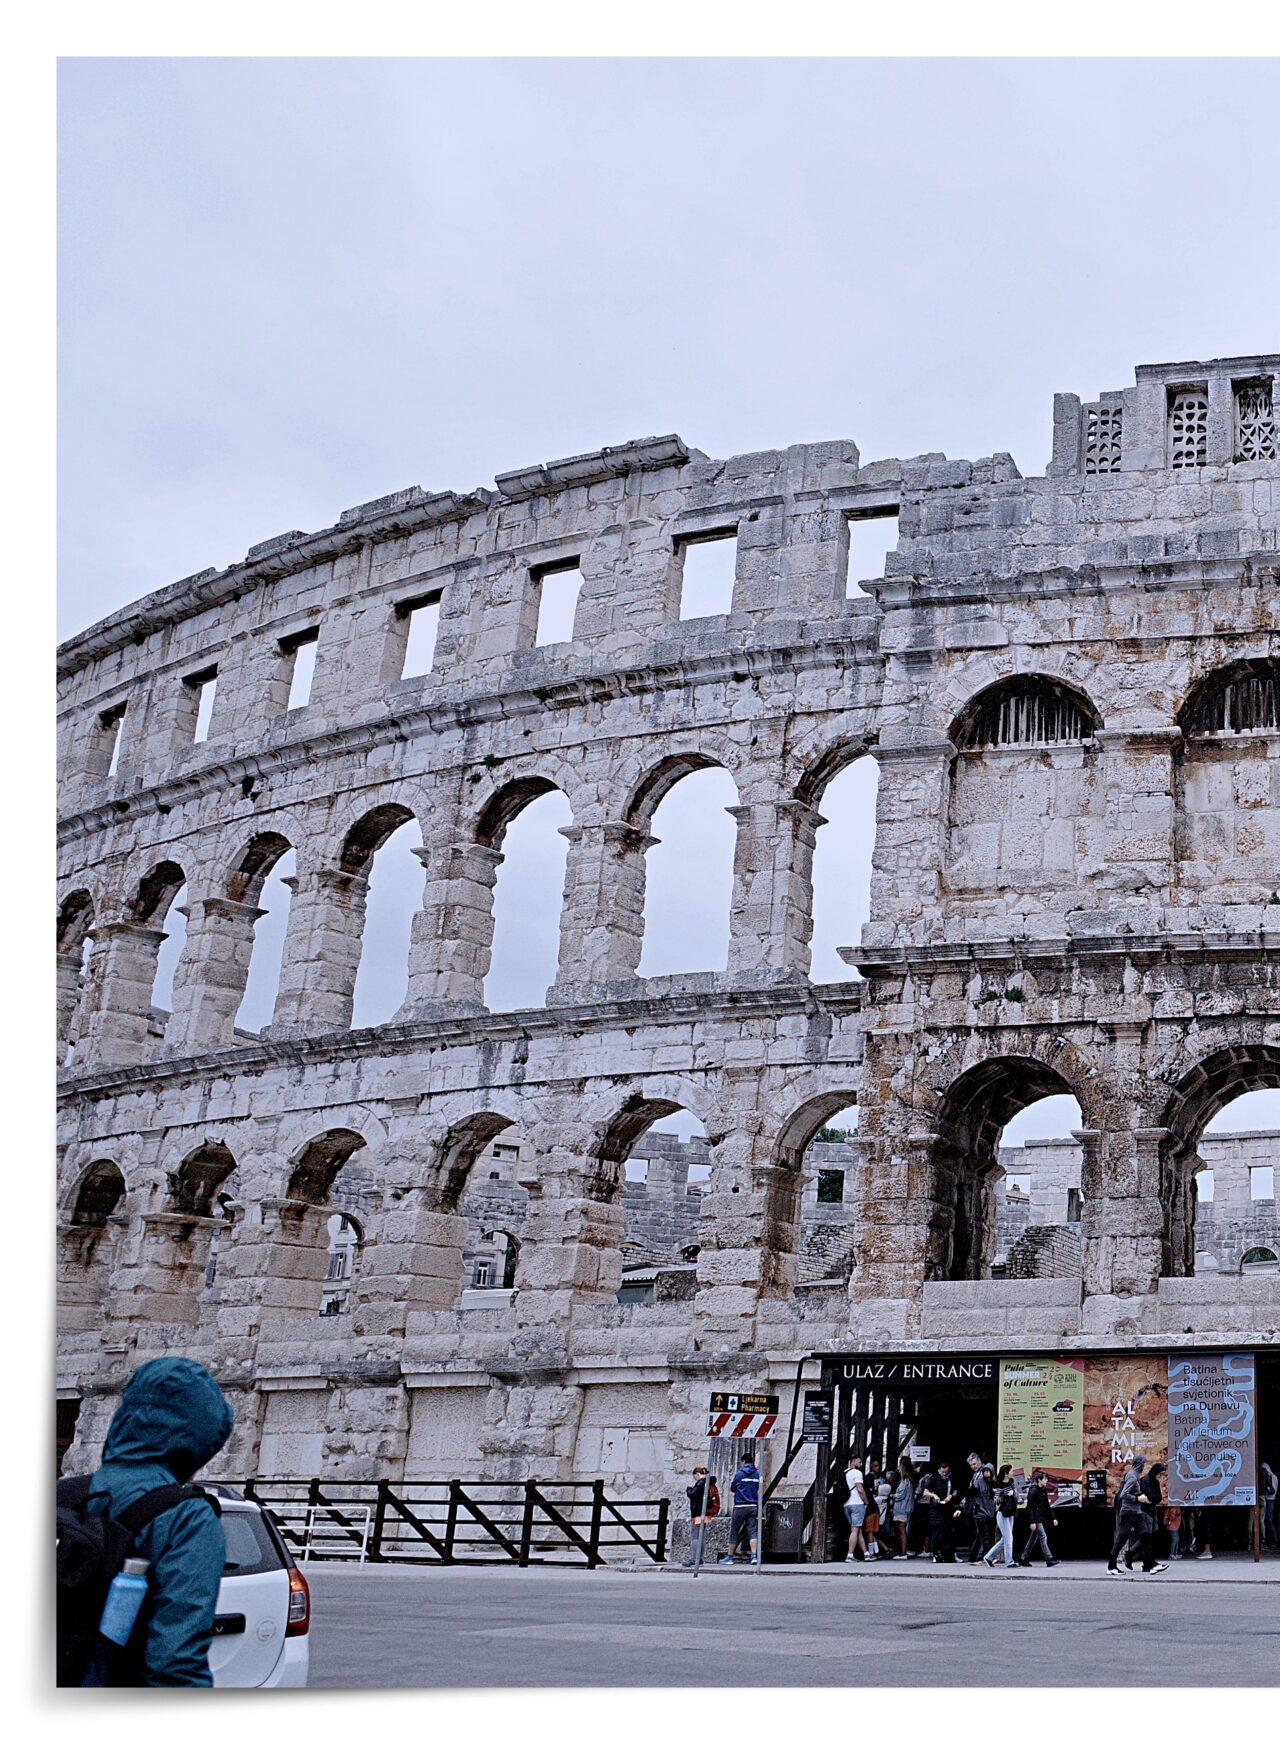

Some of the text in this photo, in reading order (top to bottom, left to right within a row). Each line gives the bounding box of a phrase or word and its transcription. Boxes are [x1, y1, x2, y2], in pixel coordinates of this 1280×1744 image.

[843, 1364, 885, 1378] ULAZ
[903, 1364, 992, 1378] ENTRANCE
[1004, 1363, 1025, 1373] Pula
[1183, 1365, 1217, 1375] Batina
[1004, 1371, 1040, 1380] SUMMER
[1003, 1379, 1013, 1389] of
[1014, 1378, 1049, 1388] Culture
[1183, 1376, 1235, 1388] tisućljetni
[742, 1395, 767, 1404] Ljekarna
[1183, 1389, 1233, 1401] svjetionik
[741, 1403, 770, 1413] Pharmacy
[1112, 1400, 1136, 1415] AL
[1183, 1401, 1240, 1411] na Dunavu
[1111, 1416, 1136, 1431] TA
[1174, 1415, 1208, 1425] Batina
[1174, 1429, 1181, 1437] a
[1111, 1432, 1135, 1447] MI
[1174, 1440, 1249, 1451] Light-Tower on
[1111, 1448, 1135, 1463] RA
[1174, 1452, 1237, 1461] the Danube
